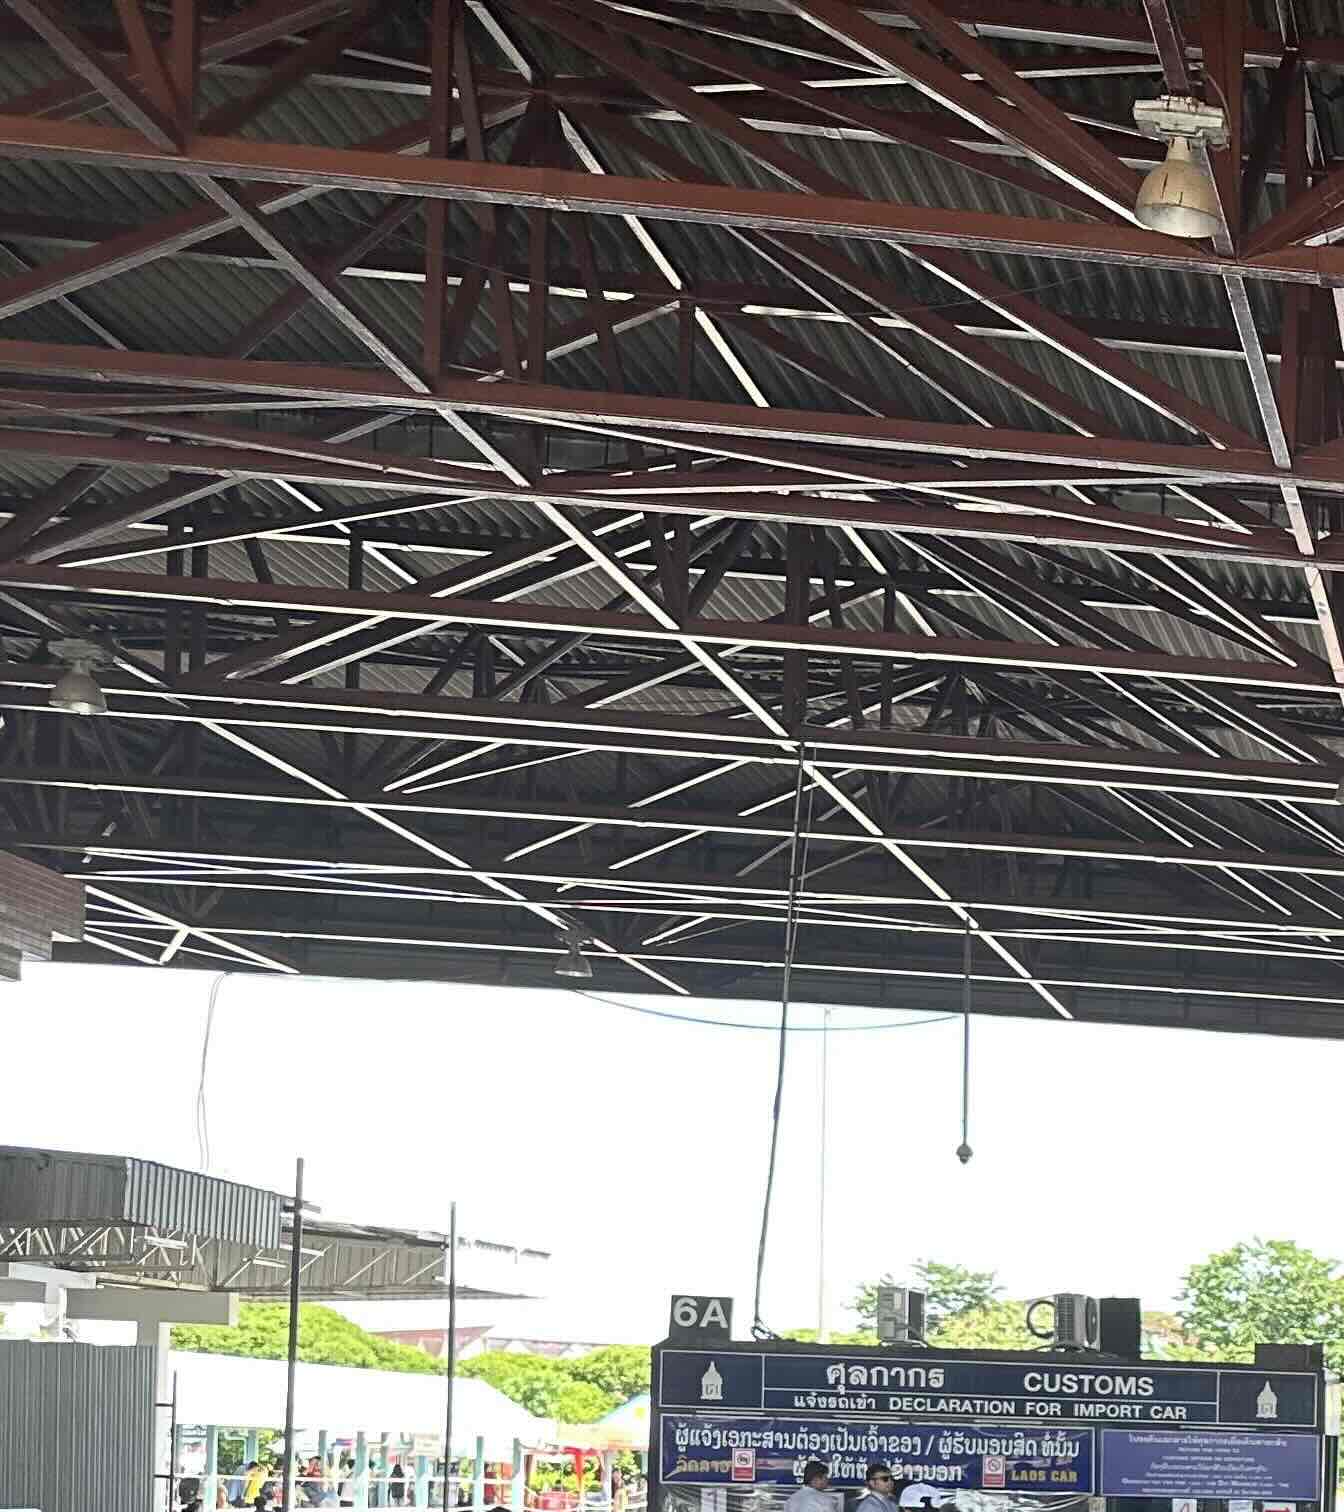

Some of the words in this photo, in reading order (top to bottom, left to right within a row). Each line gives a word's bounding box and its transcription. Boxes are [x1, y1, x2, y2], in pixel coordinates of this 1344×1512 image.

[673, 1296, 729, 1329] 6A
[826, 1362, 945, 1395] ศุลกากร
[1023, 1371, 1154, 1396] CUSTOMS
[793, 1391, 877, 1409] แจ้งรถเข้า
[889, 1397, 1015, 1416] DECLARATION
[1026, 1401, 1062, 1417] FOR
[1074, 1403, 1143, 1419] IMPORT
[1150, 1405, 1187, 1420] CAR
[1051, 1471, 1078, 1483] CAR
